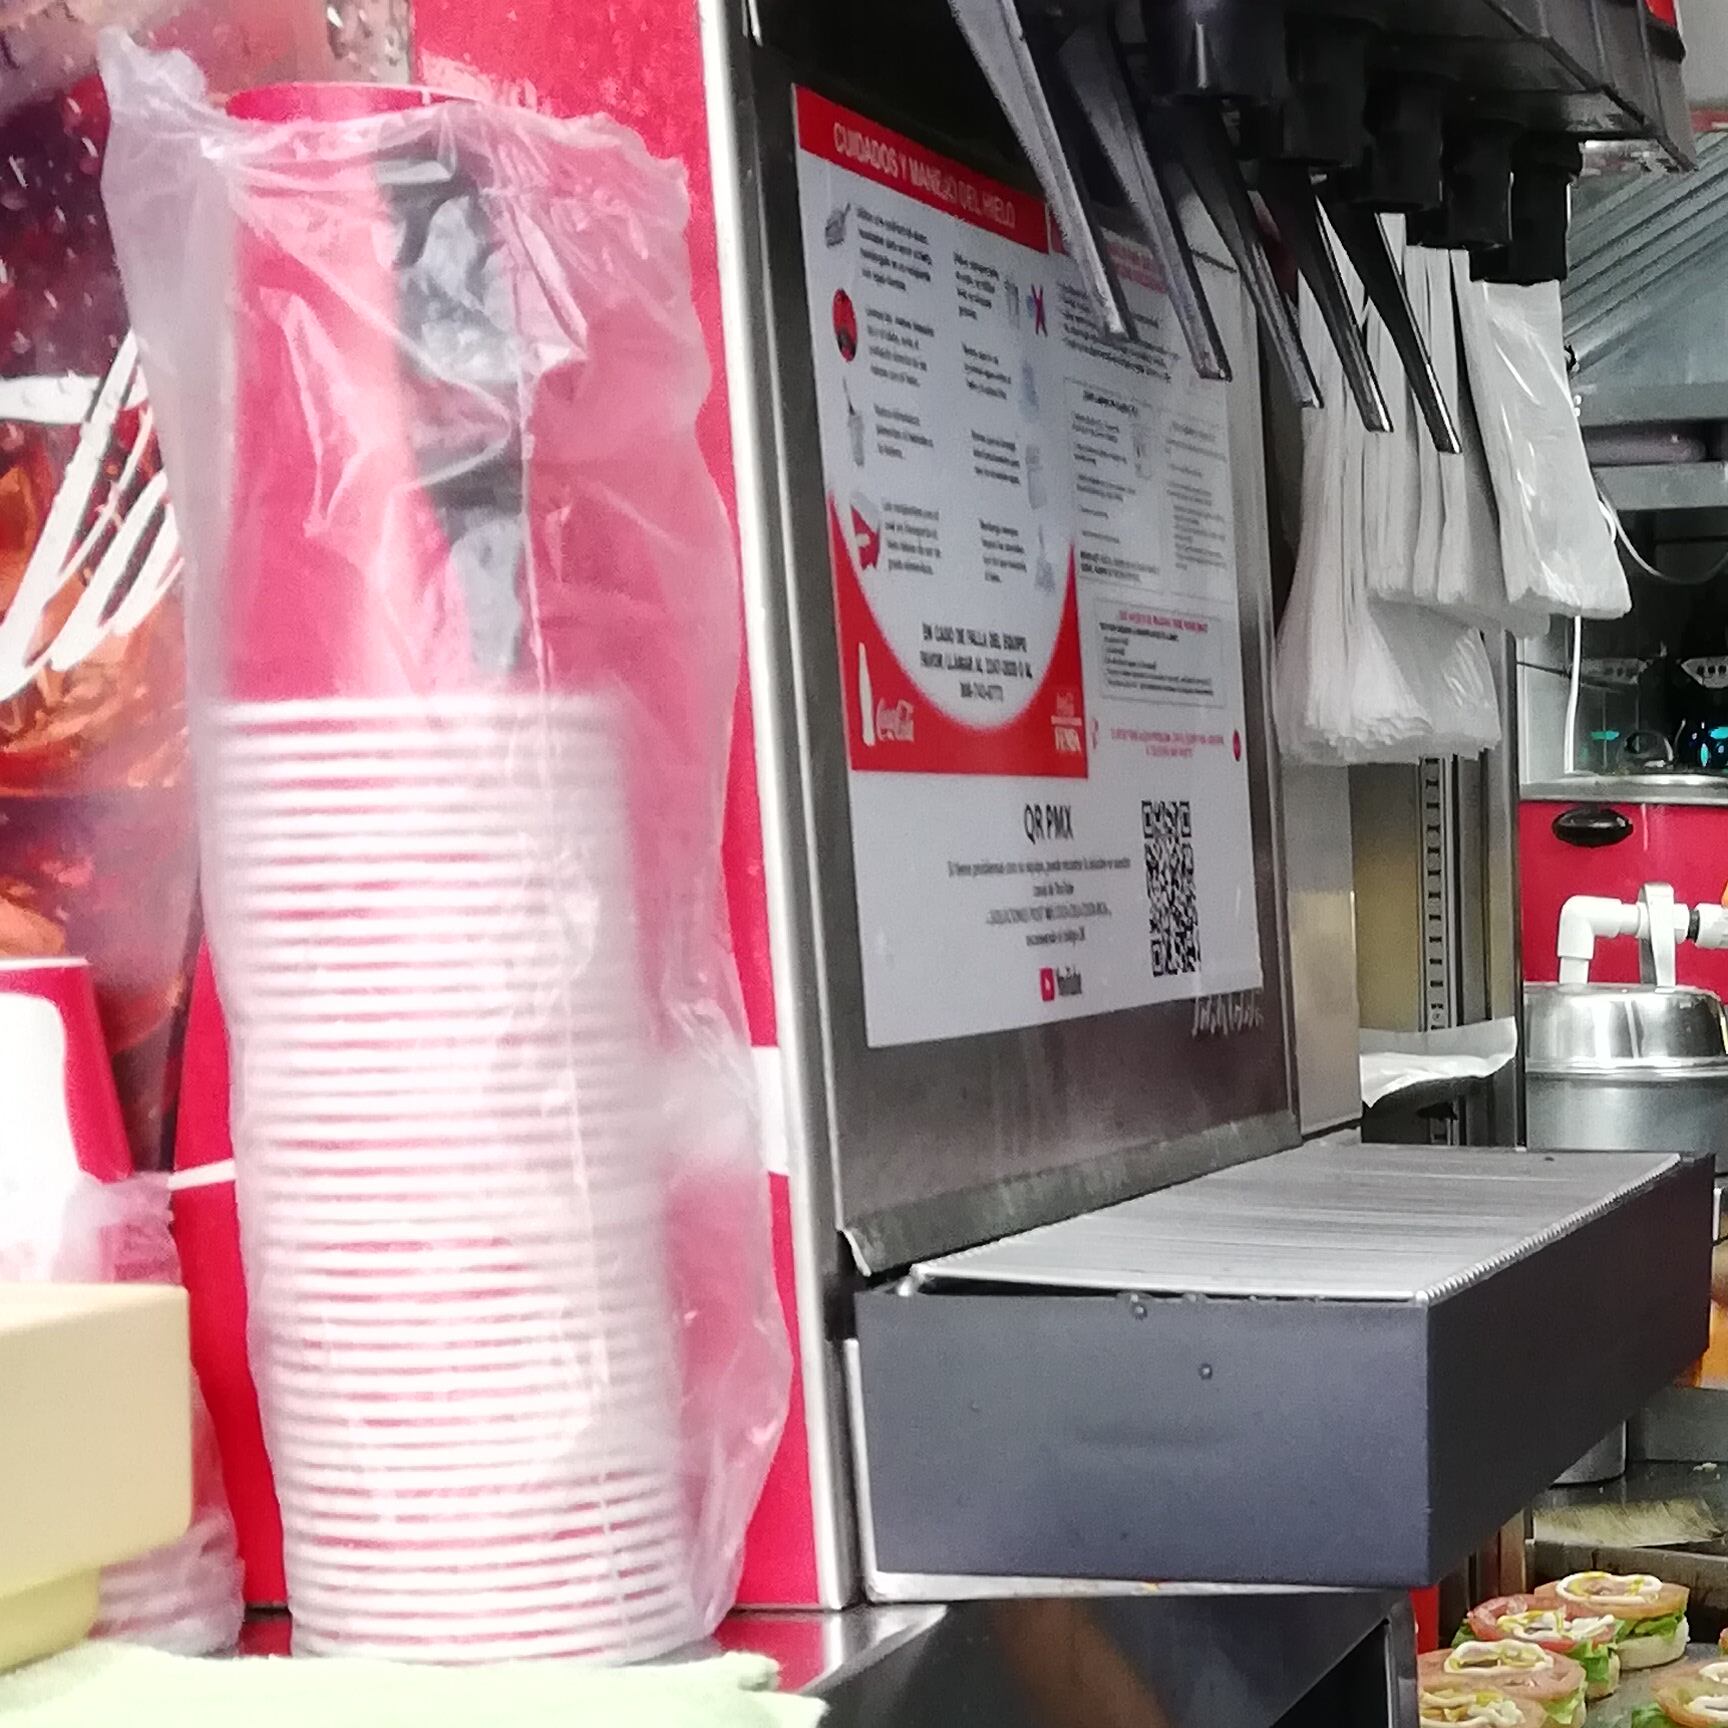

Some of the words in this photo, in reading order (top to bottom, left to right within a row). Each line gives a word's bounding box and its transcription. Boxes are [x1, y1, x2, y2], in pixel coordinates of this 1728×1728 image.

[833, 122, 898, 178] CUIDADOS
[982, 189, 1016, 228] HIELO
[1024, 803, 1045, 845] QR
[1046, 803, 1074, 839] PMX
